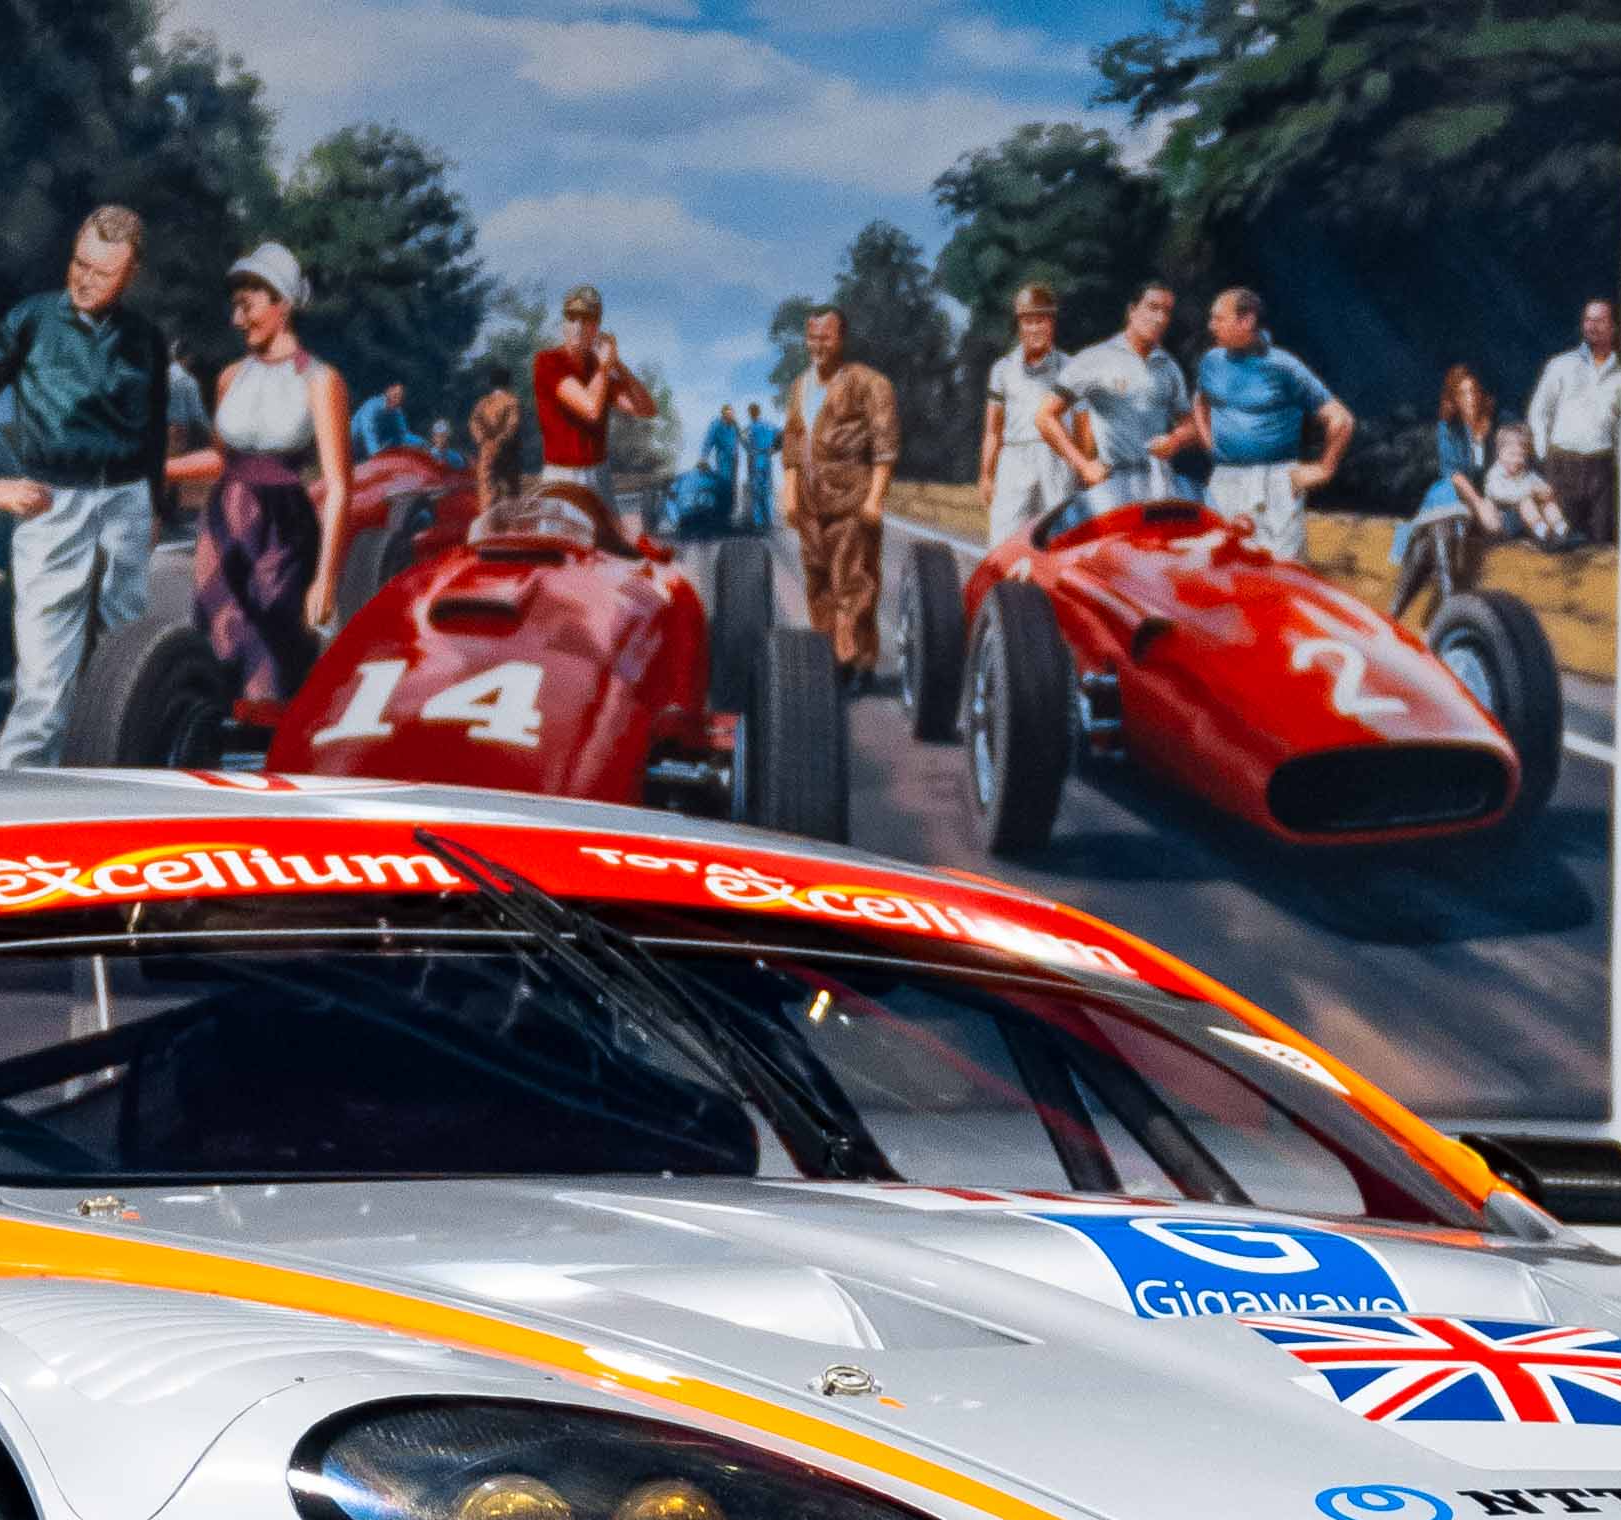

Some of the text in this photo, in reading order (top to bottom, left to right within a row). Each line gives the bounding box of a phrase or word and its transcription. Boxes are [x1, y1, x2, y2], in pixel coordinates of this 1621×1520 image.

[313, 659, 544, 748] 14
[1290, 638, 1408, 726] 2
[579, 846, 785, 885] TOTAL
[1129, 1218, 1320, 1275] G
